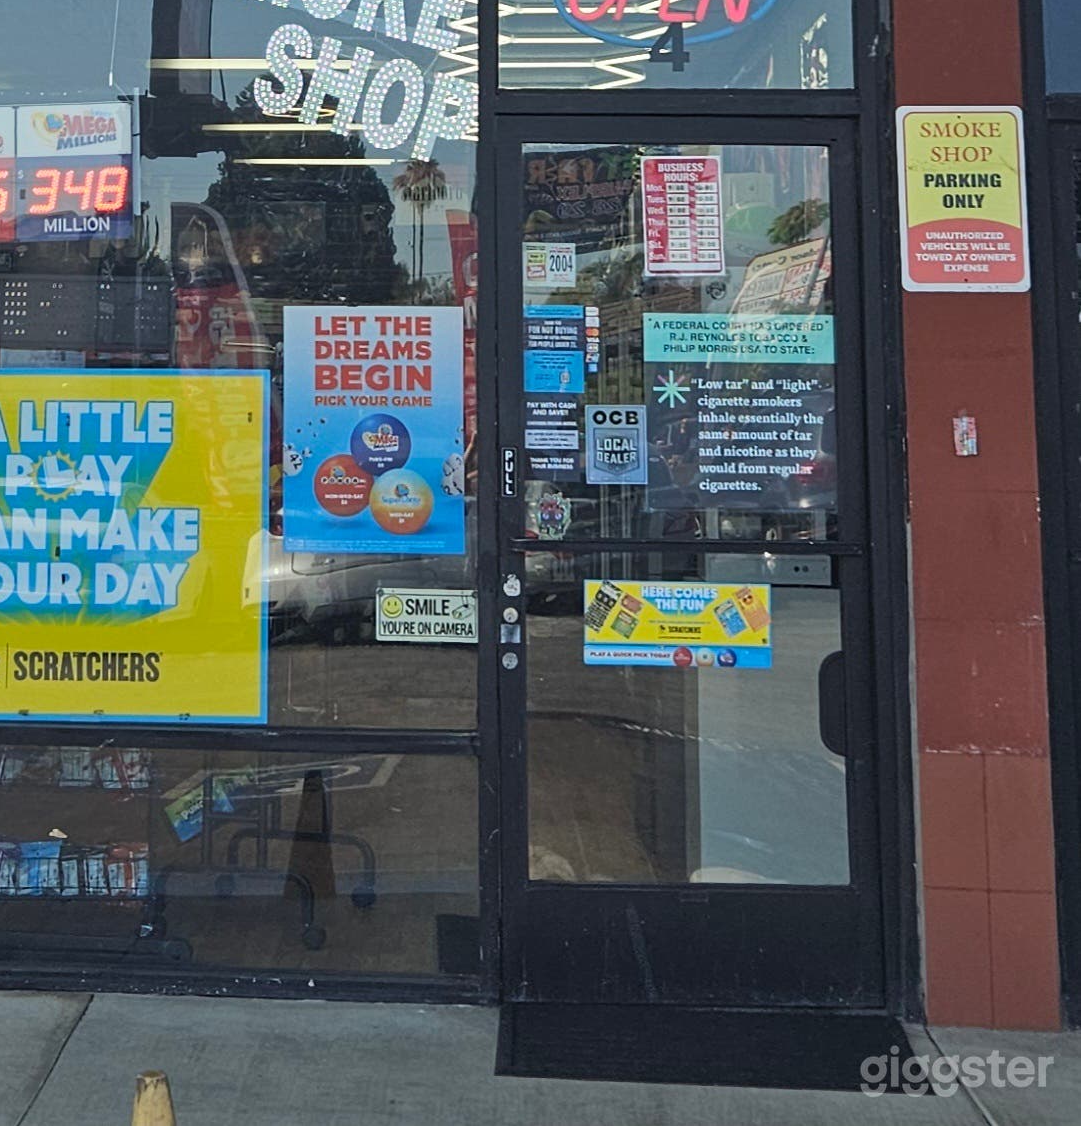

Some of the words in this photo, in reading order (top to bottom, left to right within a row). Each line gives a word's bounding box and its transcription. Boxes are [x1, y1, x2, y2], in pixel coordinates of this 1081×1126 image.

[649, 21, 690, 72] 4
[253, 23, 479, 163] SHOP
[62, 114, 116, 138] MEGA
[920, 122, 1002, 138] SMOKE
[56, 133, 117, 151] MILLIONS
[930, 146, 993, 162] SHOP
[658, 163, 704, 172] BUSINESS
[924, 173, 1002, 188] PARKING
[29, 166, 129, 214] 348
[942, 194, 984, 209] ONLY
[44, 217, 110, 233] MILLION
[926, 232, 1004, 240] UNAUTHORIZED
[920, 242, 968, 251] VEHICLES
[971, 243, 995, 251] WILL
[916, 253, 952, 261] TOWED
[944, 264, 989, 272] EXPENSE
[314, 316, 367, 336] LET
[375, 316, 432, 336] THE
[663, 321, 710, 330] FEDERAL
[315, 340, 432, 360] DREAMS
[664, 345, 696, 353] PHILIP
[698, 345, 738, 354] MORRIS
[764, 346, 778, 354] TO
[780, 346, 815, 354] STATE:
[315, 364, 433, 391] BEGIN
[751, 379, 774, 390] and
[315, 396, 347, 406] PICK
[349, 396, 388, 406] YOUR
[392, 396, 432, 406] GAME
[698, 395, 750, 409] cigarette
[752, 397, 802, 408] smokers
[20, 400, 173, 444] LITTLE
[593, 410, 638, 425] OCB
[698, 412, 736, 423] inhale
[738, 412, 802, 427] essentially
[803, 414, 824, 424] the
[698, 431, 730, 440] same
[731, 431, 778, 441] amount
[779, 429, 793, 441] of
[794, 431, 812, 441] tar
[596, 438, 637, 451] LOCAL
[596, 451, 637, 464] DEALER
[699, 446, 721, 457] and
[724, 446, 773, 457] nicotine
[775, 449, 788, 457] as
[790, 447, 817, 460] they
[5, 450, 133, 498] PLAY
[504, 450, 513, 494] PULL
[699, 463, 736, 474] would
[738, 463, 767, 474] from
[769, 463, 814, 477] regular
[699, 479, 762, 493] cigarettes.
[59, 507, 200, 552] MAKE
[94, 562, 189, 606] DAY
[642, 586, 672, 599] HERE
[673, 587, 718, 599] COMES
[405, 599, 450, 616] SMILE
[655, 599, 678, 610] THE
[680, 599, 705, 611] FUN
[382, 621, 416, 635] YOU'RE
[418, 622, 431, 635] ON
[434, 623, 474, 635] CAMERA
[13, 650, 161, 682] SCRATCHERS
